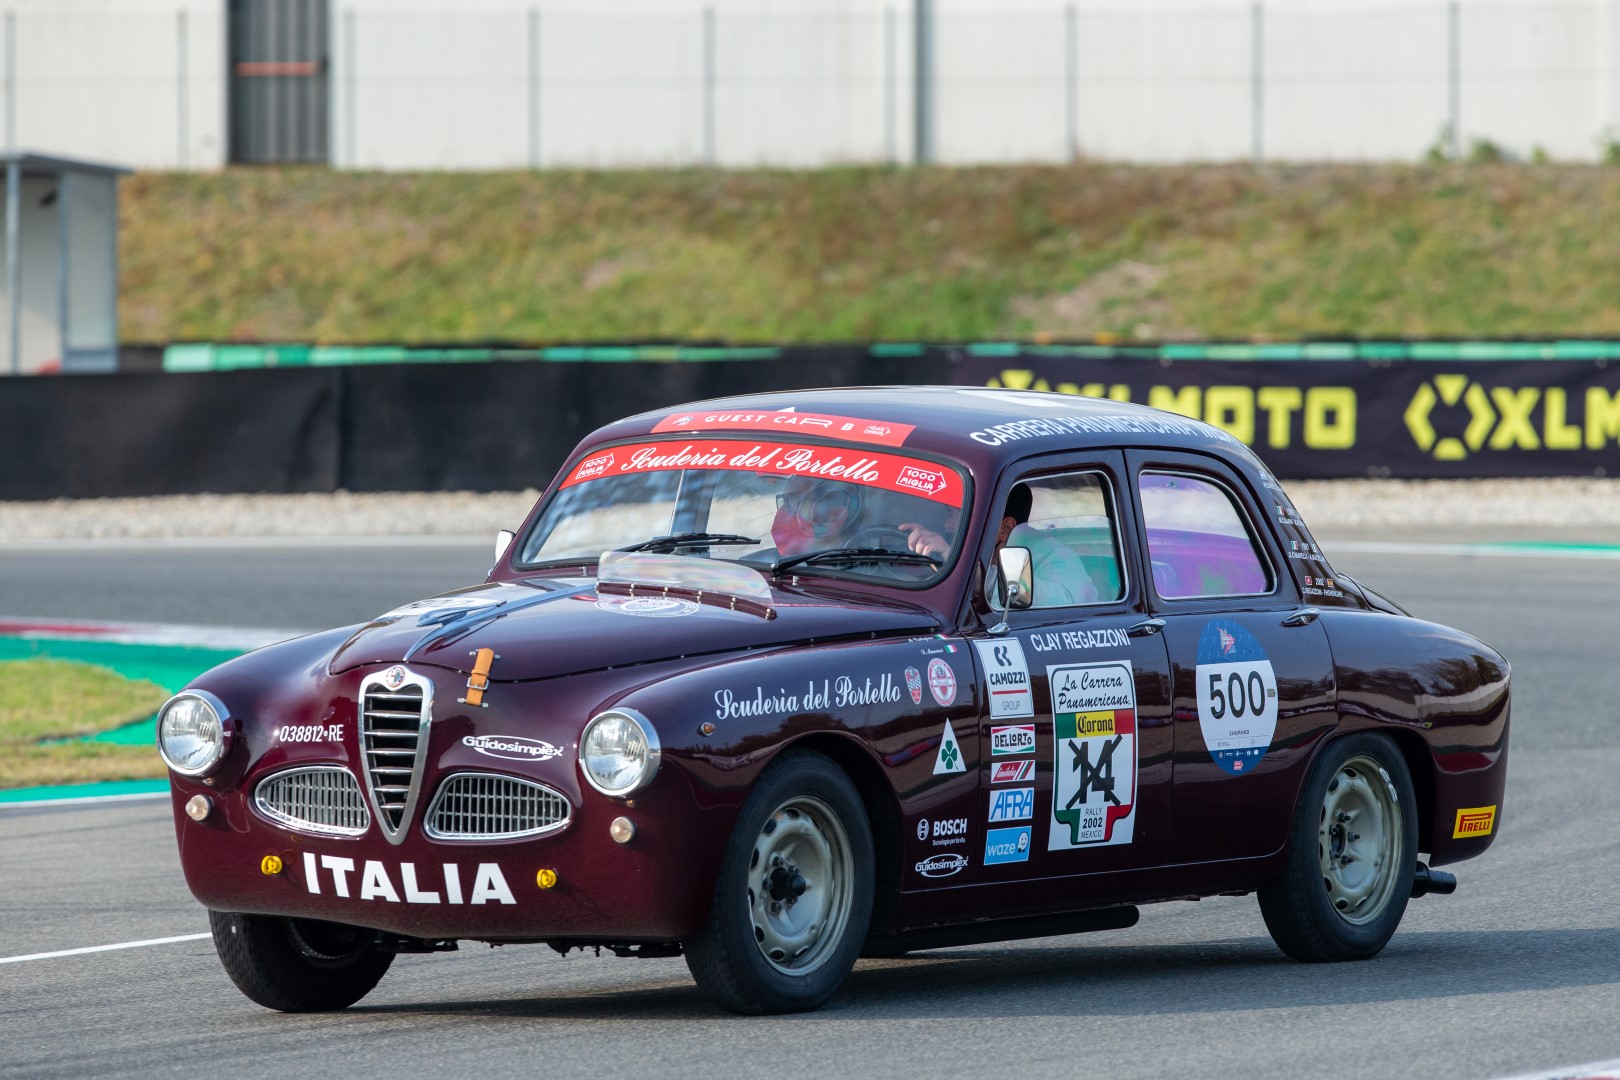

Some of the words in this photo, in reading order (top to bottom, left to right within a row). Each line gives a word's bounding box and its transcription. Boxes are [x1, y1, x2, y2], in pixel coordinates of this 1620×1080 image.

[705, 415, 761, 423] GUEST
[774, 416, 833, 428] CAR
[841, 422, 854, 431] B
[970, 418, 1065, 446] CARRERA
[1063, 415, 1198, 437] PANAMERICANA
[586, 458, 606, 468] 1000
[621, 445, 727, 471] Scuderia
[730, 446, 770, 467] del
[776, 448, 879, 482] Portello
[900, 476, 934, 491] MIGLIA
[907, 469, 936, 481] 1000
[1031, 632, 1061, 651] CLAY
[1061, 628, 1131, 650] REGAZZONI
[990, 671, 1026, 685] CAMOZZI
[1062, 674, 1078, 692] La
[1081, 672, 1123, 689] Carrera
[714, 687, 799, 719] Scuderia
[803, 679, 830, 711] del
[835, 672, 901, 707] Portello
[1058, 692, 1129, 709] Panamericana
[1209, 670, 1265, 720] 500
[1002, 700, 1021, 711] GROUP
[1077, 715, 1114, 735] Corona
[990, 790, 1033, 820] AFRA
[1085, 807, 1102, 816] RALLY
[933, 818, 968, 836] BOSCH
[1083, 817, 1103, 829] 2002
[1458, 812, 1492, 832] PIRELLI
[1081, 829, 1102, 838] MEXICO
[988, 841, 1016, 857] waze
[915, 856, 968, 872] Guidosimplex
[303, 852, 517, 905] ITALIA
